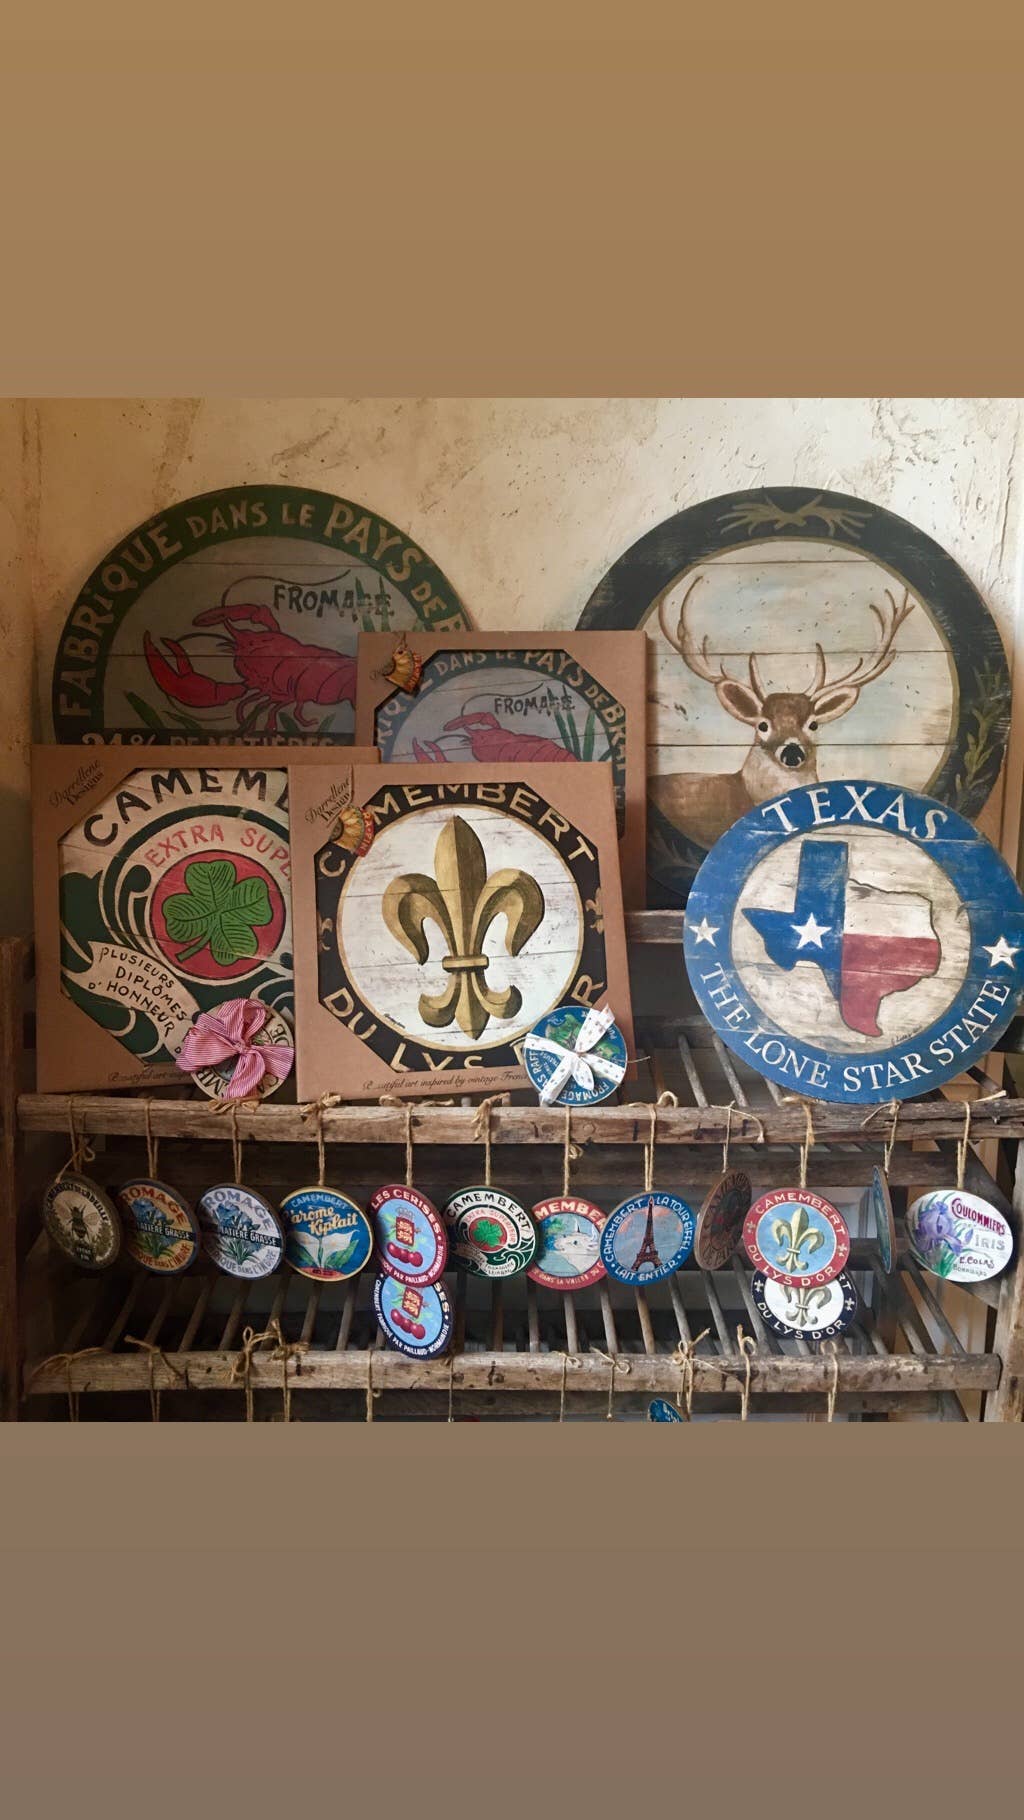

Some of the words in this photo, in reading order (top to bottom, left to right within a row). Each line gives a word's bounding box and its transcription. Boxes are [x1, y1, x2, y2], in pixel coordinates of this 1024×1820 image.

[186, 502, 269, 539] DANS
[282, 503, 315, 528] LE
[323, 502, 423, 583] PAYS
[411, 584, 447, 618] DE
[273, 584, 395, 622] FROMAGE
[586, 685, 610, 711] DE
[318, 783, 595, 878] CMEMBERT
[761, 785, 948, 840] TEXAS
[144, 824, 224, 868] EXTRA
[100, 947, 174, 989] PLUSIEURS
[115, 966, 187, 1021] DIPLÔMES
[323, 987, 377, 1040] DU
[699, 963, 751, 1031] THE
[744, 1026, 831, 1088] LONE
[843, 1052, 933, 1092] STAR
[929, 980, 1010, 1066] STATE
[291, 1193, 349, 1209] CAMEMBERT
[371, 1190, 391, 1210] LES
[393, 1189, 442, 1238] CERISES
[448, 1193, 533, 1235] CAMEMBERT
[755, 1192, 846, 1236] CAMEMBERT
[604, 1198, 645, 1263] CAMEMBERT
[974, 1233, 1005, 1251] IRIS
[614, 1266, 637, 1281] LAIT
[637, 1259, 679, 1282] ENTIER
[748, 1244, 763, 1262] DU
[762, 1264, 793, 1286] LYS
[801, 1265, 837, 1288] D'OR
[757, 1302, 774, 1319] DU
[773, 1320, 804, 1341] LYS
[811, 1318, 847, 1341] D'OR
